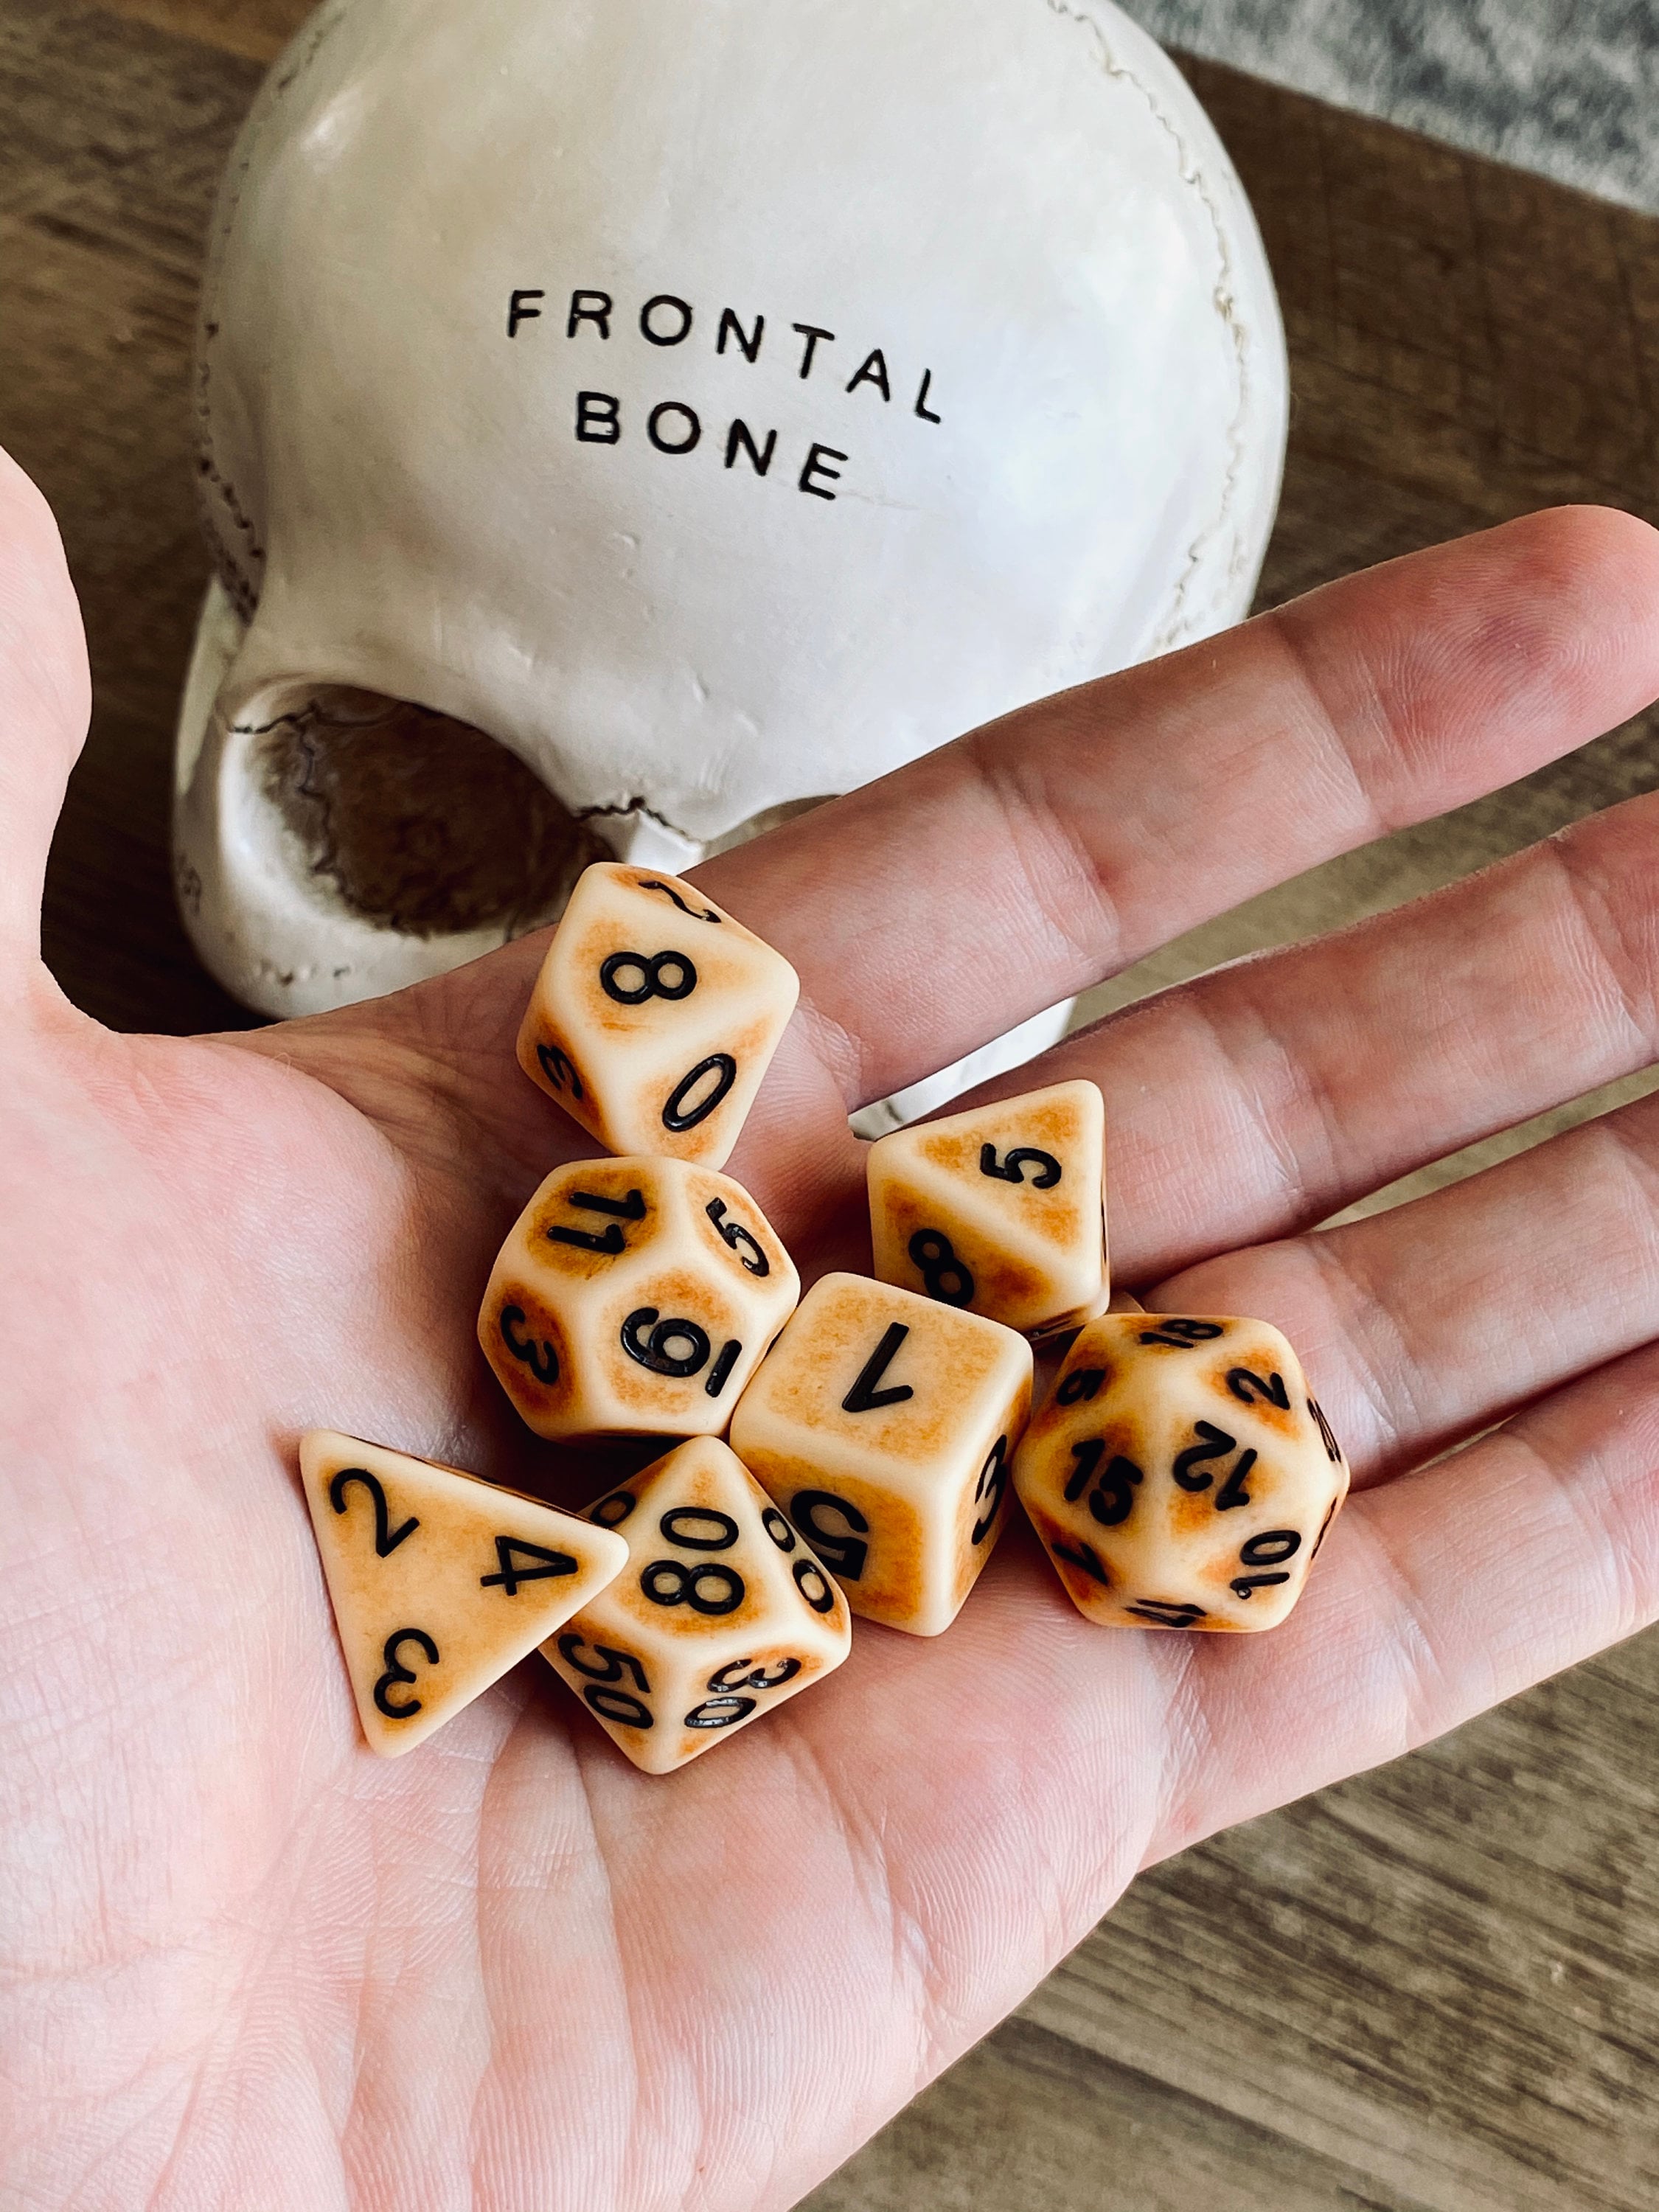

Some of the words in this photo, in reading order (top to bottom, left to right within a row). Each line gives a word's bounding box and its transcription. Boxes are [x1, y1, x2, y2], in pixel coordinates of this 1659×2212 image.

[507, 290, 941, 424] FRONTAL
[576, 391, 849, 500] BONE
[600, 950, 698, 1005] 8
[662, 1053, 737, 1133] 0
[980, 1143, 1062, 1189] 5
[547, 1189, 647, 1255] 11
[705, 1197, 770, 1277] 5
[908, 1228, 975, 1308] 8
[500, 1304, 560, 1385] 3
[1227, 1367, 1290, 1411] 2
[971, 1434, 1008, 1546] 3
[1063, 1437, 1144, 1526] 15
[1172, 1419, 1258, 1512] 12
[330, 1467, 420, 1559] 2
[790, 1489, 869, 1582] 5
[479, 1536, 579, 1596] 4
[1230, 1529, 1302, 1600] 10
[373, 1628, 440, 1719] 3
[557, 1633, 655, 1730] 50
